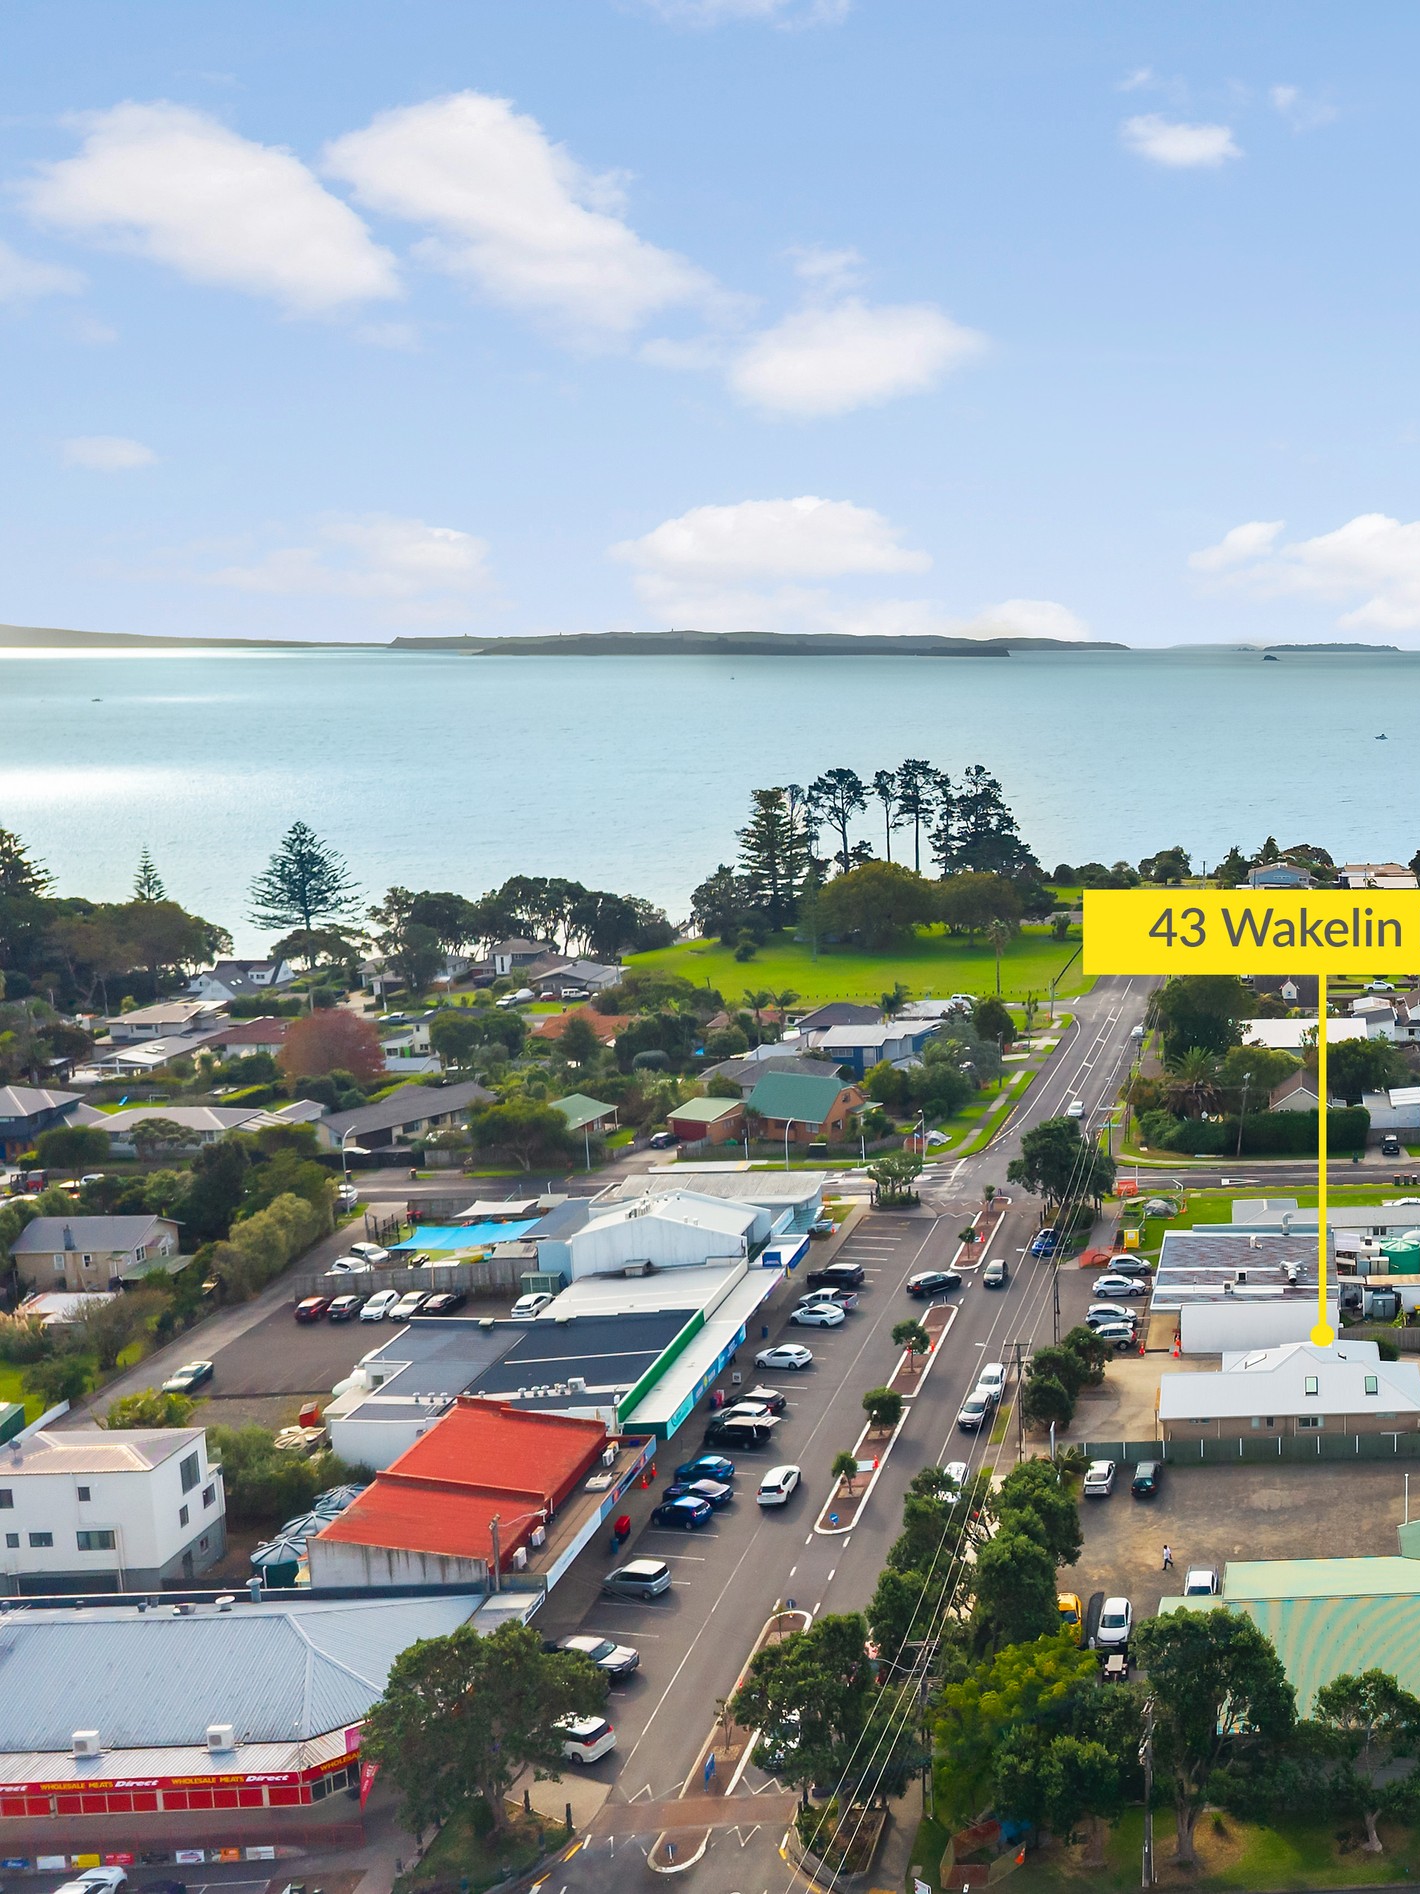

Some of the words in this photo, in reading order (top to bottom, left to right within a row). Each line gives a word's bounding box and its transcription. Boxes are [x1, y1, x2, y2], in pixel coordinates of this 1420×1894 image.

[115, 1780, 158, 1788] Direct
[171, 1777, 216, 1786] WHOLESALE
[219, 1776, 244, 1784] MEATS
[246, 1775, 289, 1783] Direct
